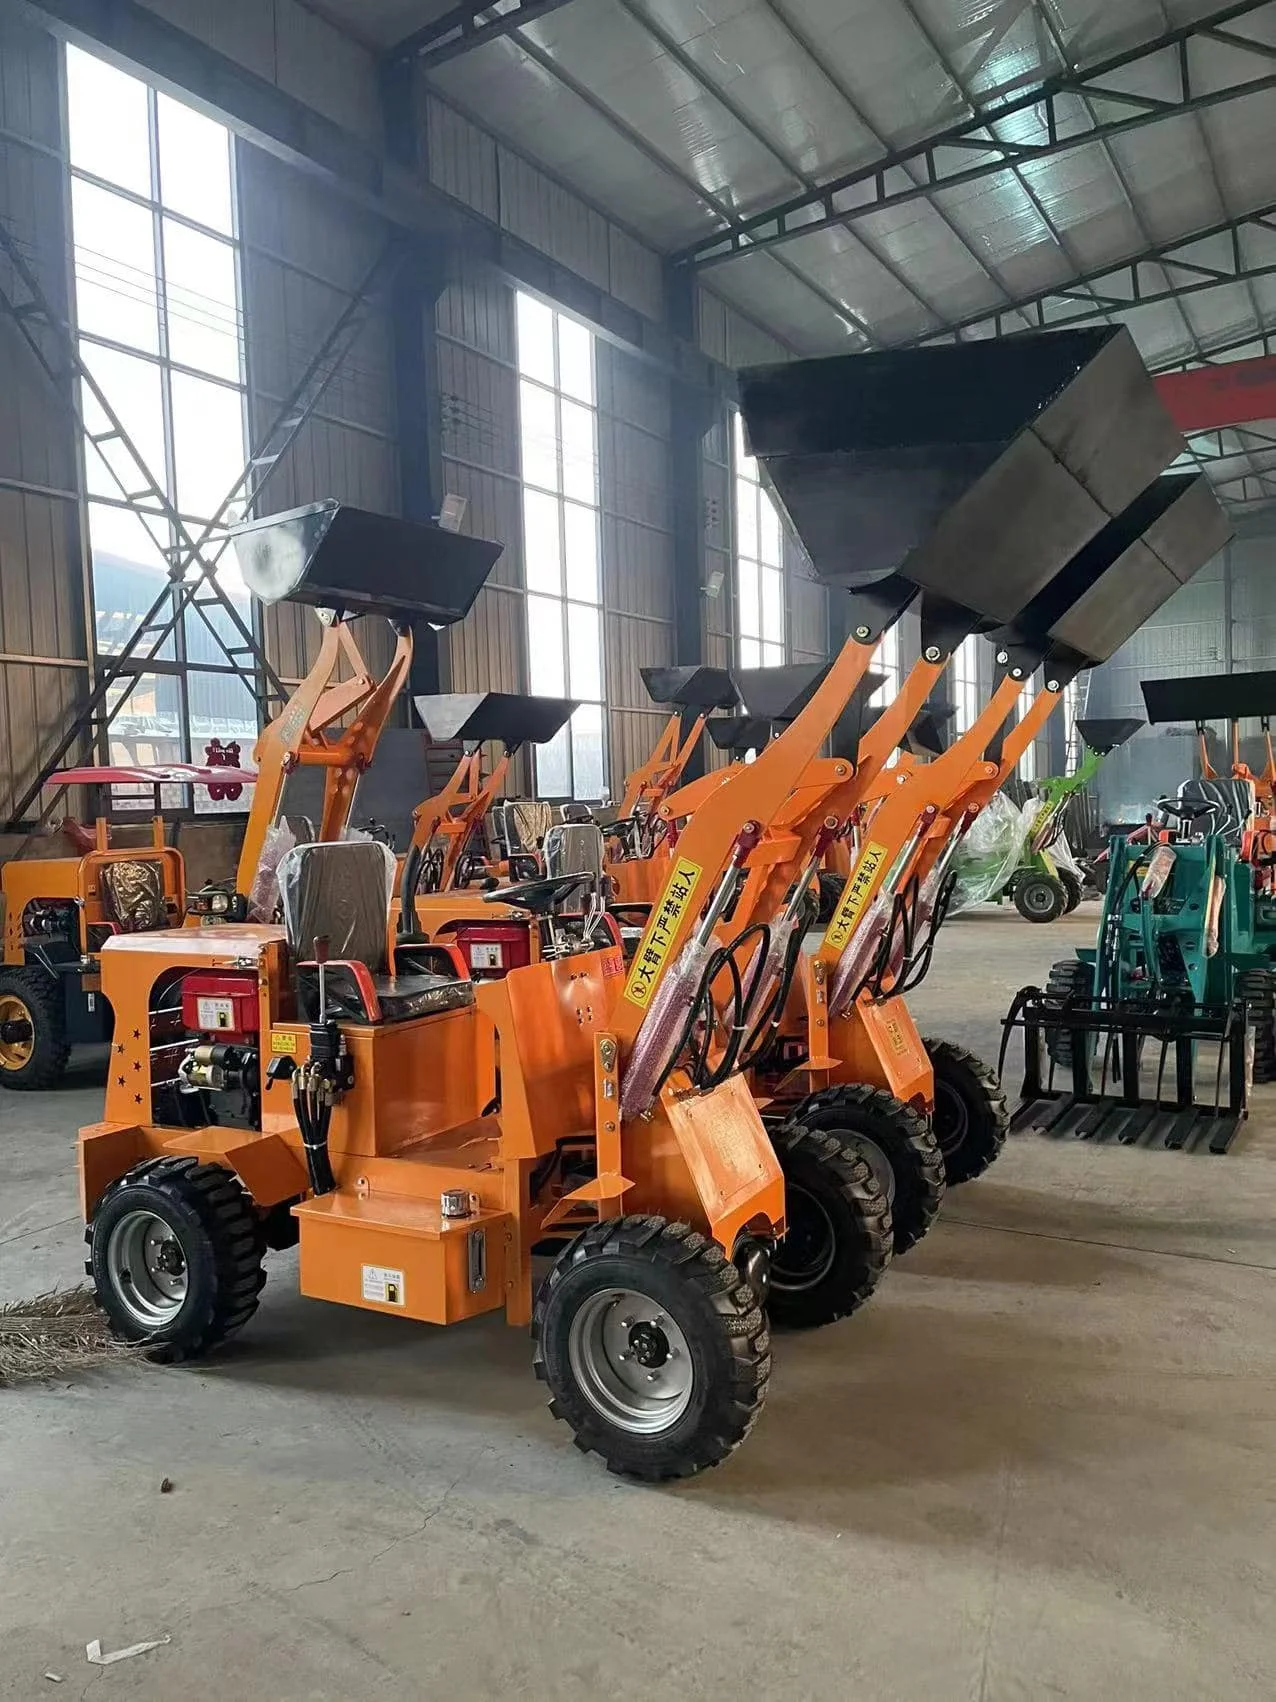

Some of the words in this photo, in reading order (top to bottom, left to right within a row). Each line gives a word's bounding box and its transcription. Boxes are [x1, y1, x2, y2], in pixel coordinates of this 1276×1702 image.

[638, 870, 695, 983] 大臂下严禁站人
